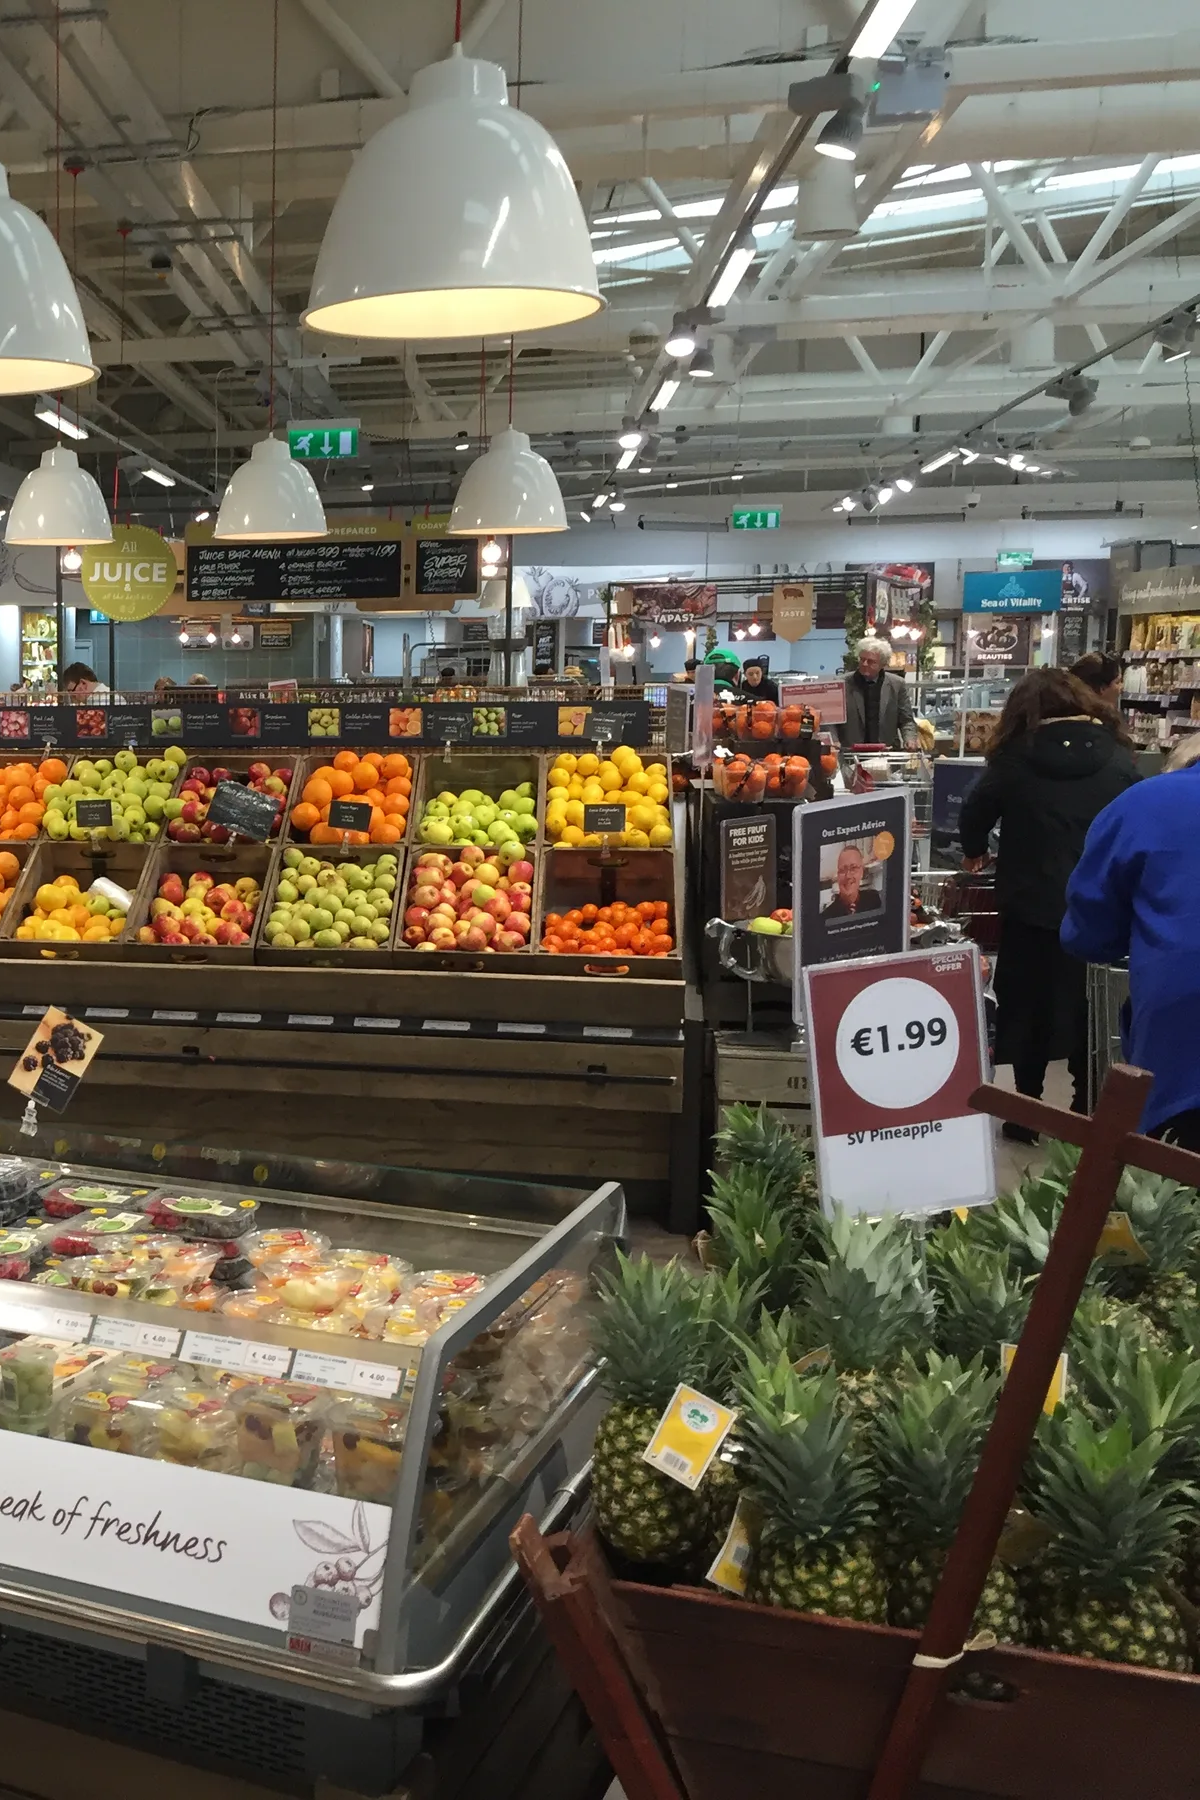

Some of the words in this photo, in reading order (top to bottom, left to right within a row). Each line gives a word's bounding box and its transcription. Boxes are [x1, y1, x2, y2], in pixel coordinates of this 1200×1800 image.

[328, 527, 377, 536] PREPARED
[417, 522, 448, 530] TODAY'
[121, 541, 137, 553] All
[199, 549, 225, 560] JUICE
[228, 549, 251, 559] BAR
[252, 548, 281, 559] MENU
[423, 554, 468, 570] SUPER
[89, 562, 167, 582] JUICE
[424, 565, 467, 579] GREEN
[124, 583, 131, 592] &
[981, 599, 998, 607] Sea
[999, 599, 1008, 607] of
[1010, 597, 1042, 607] Vitality
[653, 613, 694, 623] TAPAS?
[730, 827, 746, 837] FREE
[747, 825, 767, 835] FRUIT
[822, 829, 835, 838] Our
[836, 824, 860, 836] Expert
[861, 820, 886, 831] Advice
[733, 837, 747, 846] FOR
[748, 835, 764, 844] KIDS
[931, 953, 965, 965] SPECIAL
[935, 962, 962, 973] OFFER
[850, 1017, 947, 1056] €1.99
[847, 1132, 865, 1145] SV
[870, 1120, 943, 1142] Pineapple
[369, 1373, 385, 1381] 4.00
[52, 1496, 88, 1535] of
[84, 1500, 228, 1563] freshness
